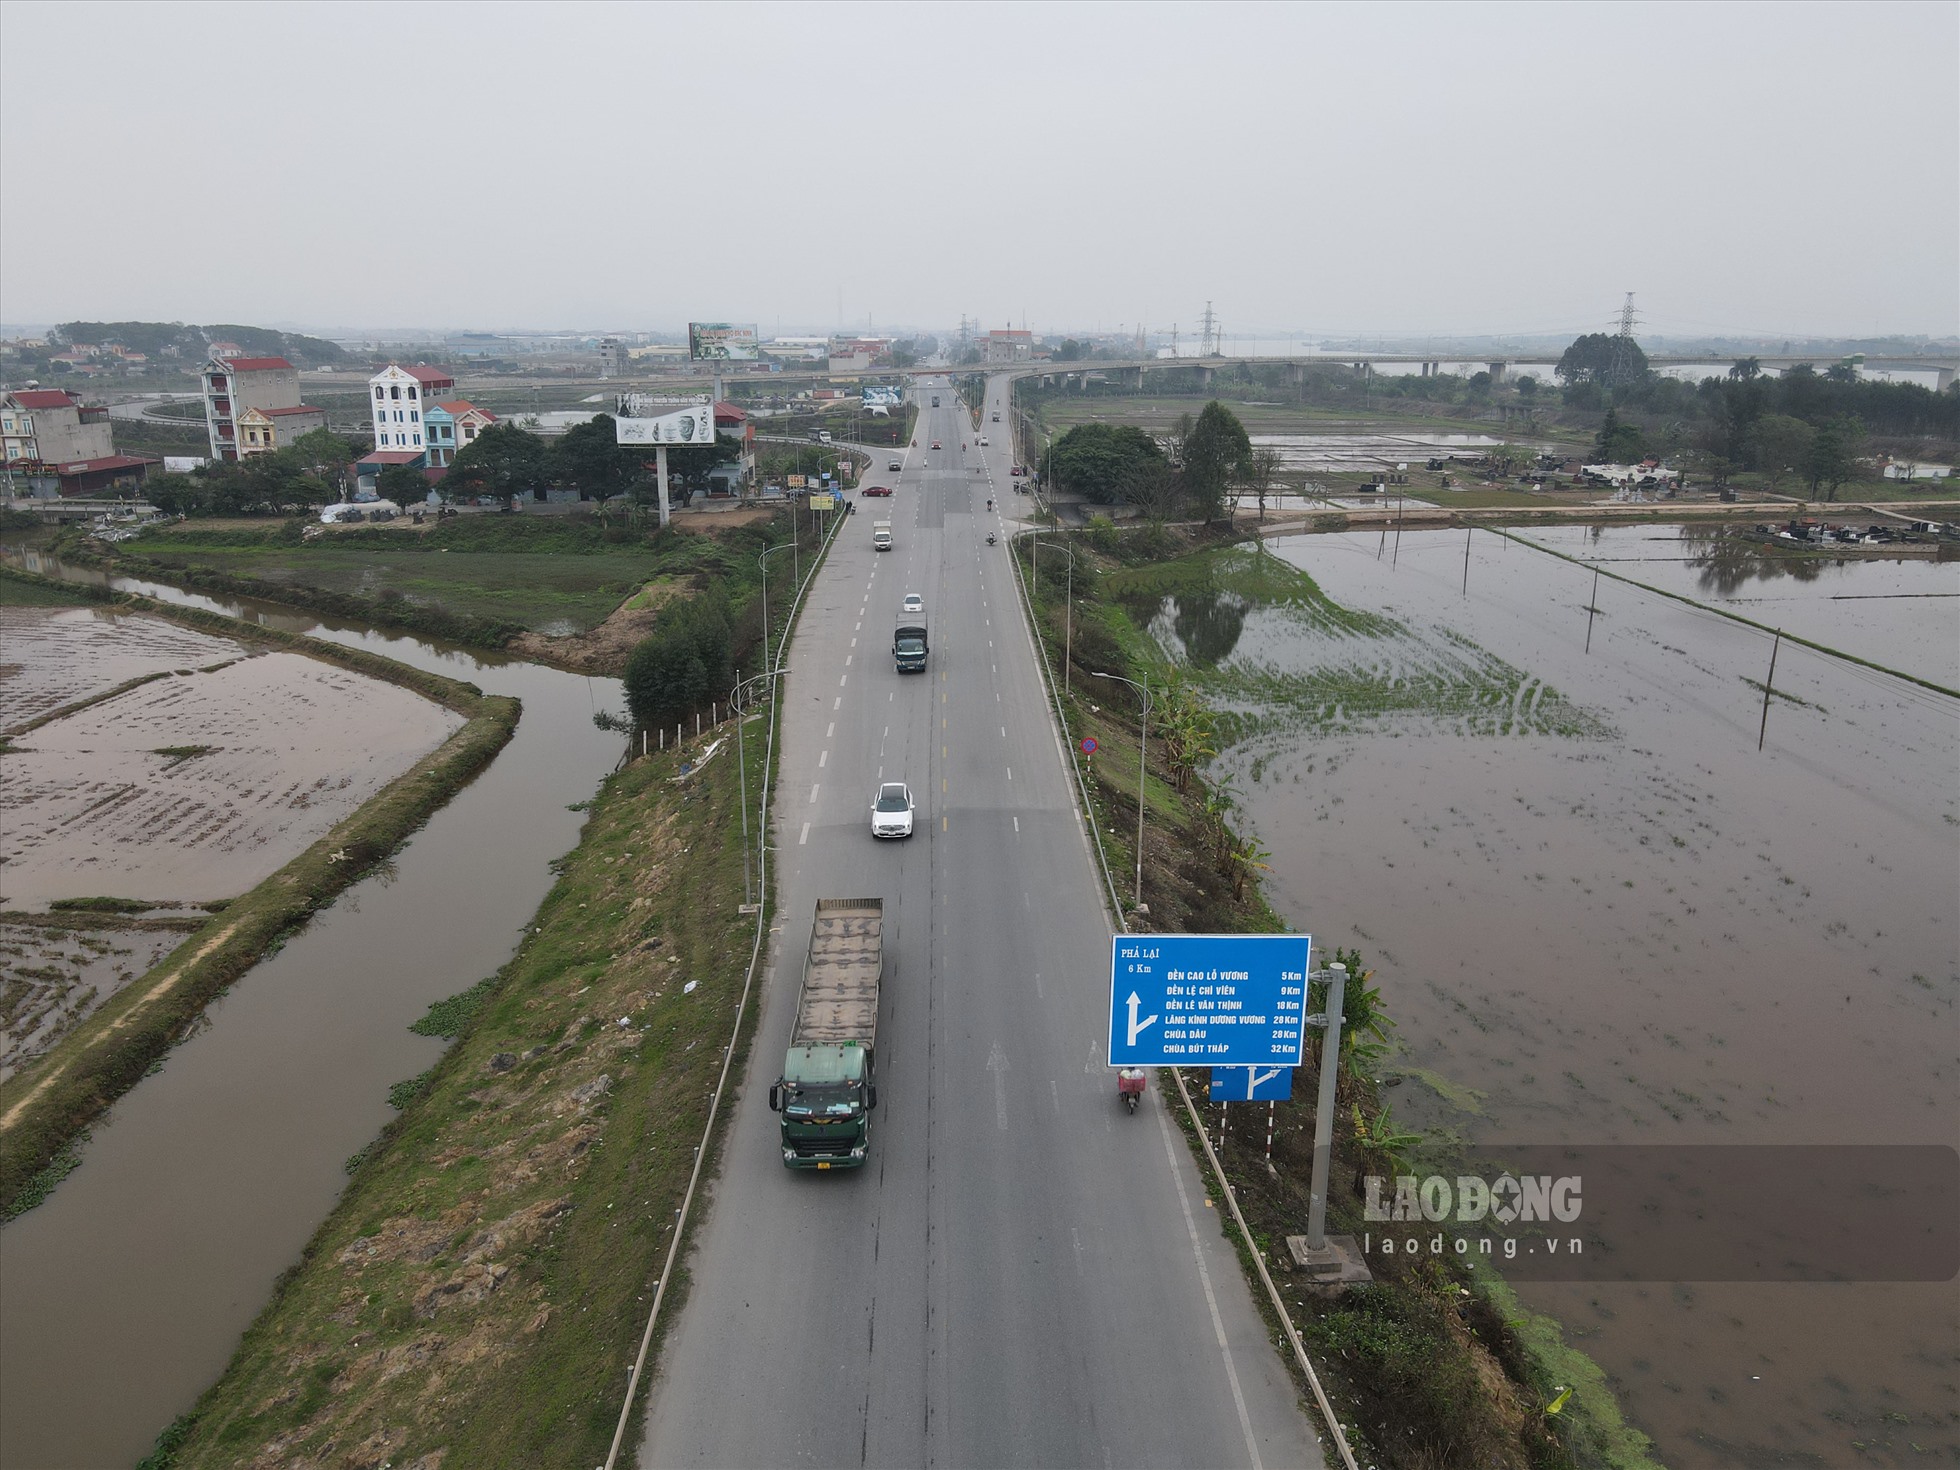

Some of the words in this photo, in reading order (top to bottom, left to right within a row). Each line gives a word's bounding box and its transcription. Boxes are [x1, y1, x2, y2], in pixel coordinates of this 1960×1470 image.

[1121, 945, 1140, 958] PHẢ
[1128, 963, 1134, 973] 6
[1136, 963, 1152, 973] Km
[1167, 968, 1185, 981] ĐỀN
[1187, 971, 1205, 981] CAO
[1220, 970, 1249, 981] VƯƠNG
[1166, 983, 1184, 996] ĐỀN
[1165, 998, 1183, 1010] ĐỀN
[1217, 1000, 1243, 1011] THỊNH
[1239, 1014, 1266, 1025] VƯƠNG
[1188, 1043, 1204, 1053] BÚT
[1207, 1043, 1230, 1053] THÁP
